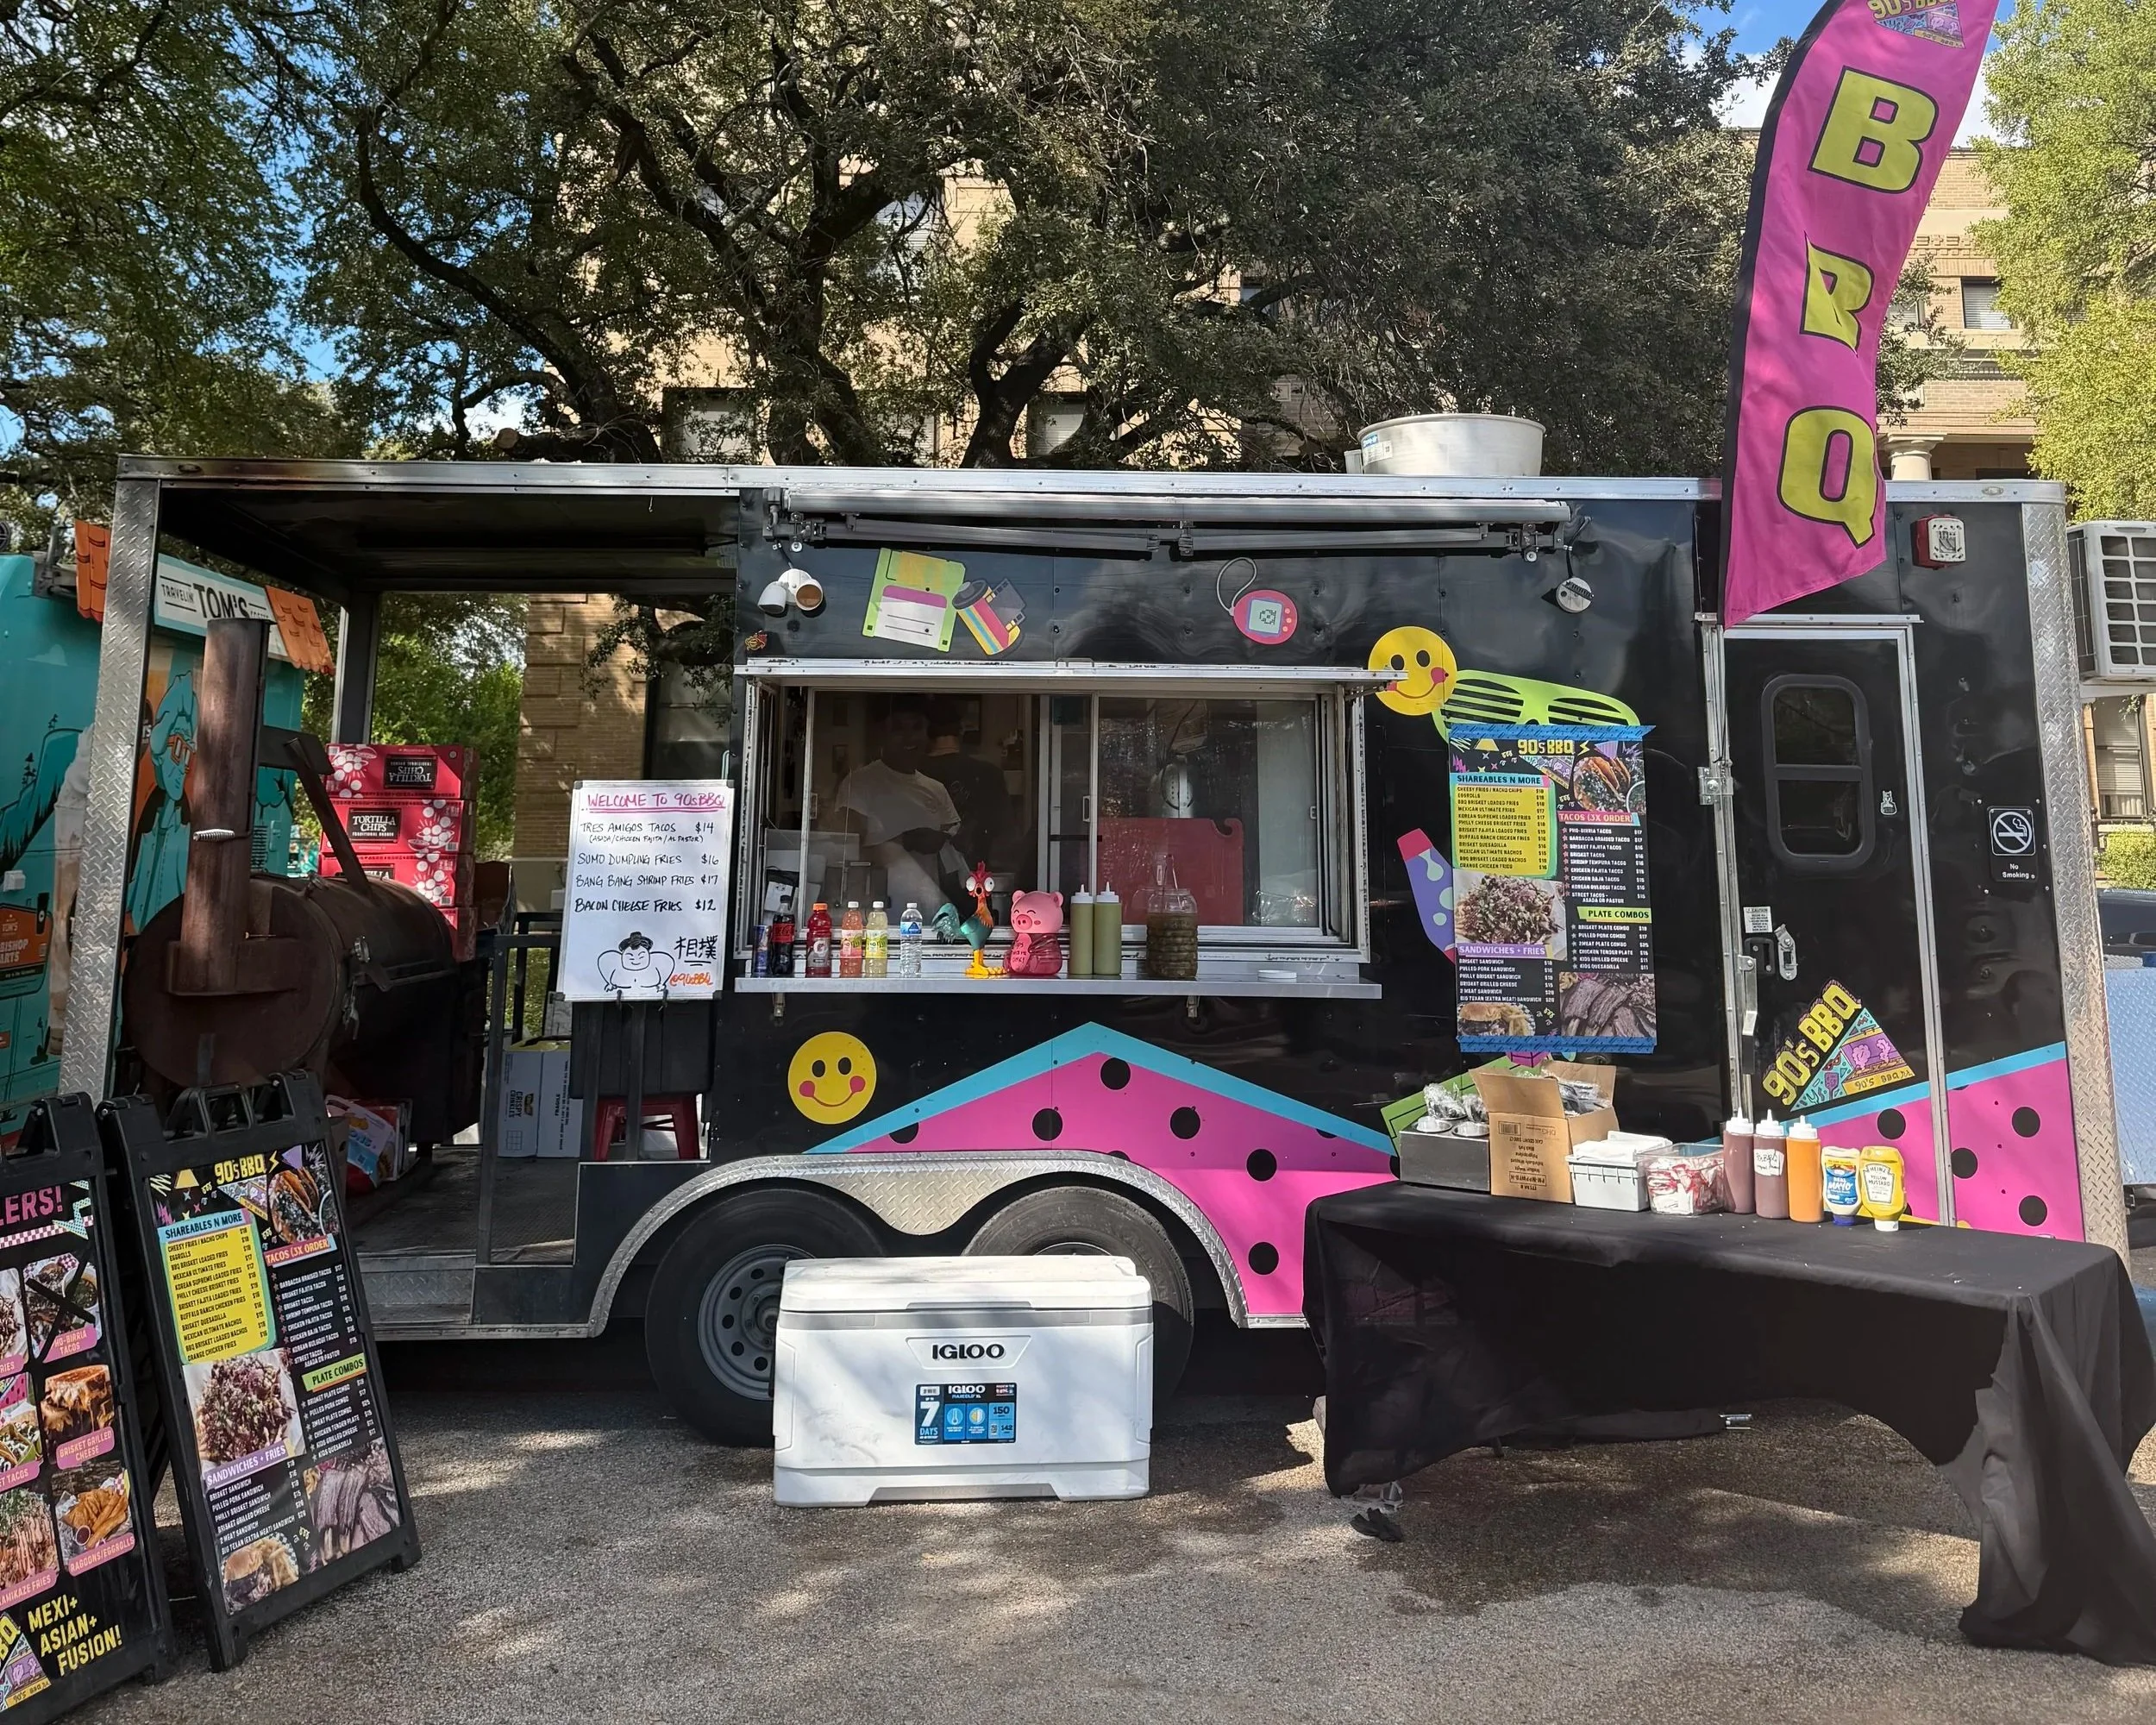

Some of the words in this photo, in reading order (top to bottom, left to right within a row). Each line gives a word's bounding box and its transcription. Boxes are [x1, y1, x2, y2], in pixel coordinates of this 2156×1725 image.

[193, 583, 249, 618] TOM'S
[1546, 739, 1576, 755] BBQ
[389, 772, 432, 782] TORTILLA
[398, 766, 424, 775] CHIPS
[1457, 775, 1508, 784] SHAREABLES
[1518, 776, 1541, 785] MORE
[587, 794, 646, 806] WELCOME
[352, 815, 396, 825] TORTILLA
[1558, 812, 1585, 821] TACOS
[1587, 812, 1601, 822] (3X
[360, 823, 387, 832] CHIPS
[580, 823, 604, 833] TRES
[607, 823, 643, 832] AMIGOS
[649, 823, 676, 832] TACOS
[695, 822, 714, 834] $14
[577, 852, 605, 864] SUMO
[608, 853, 650, 865] DUMPLING
[655, 855, 682, 865] FRIES
[701, 853, 719, 865] $16
[576, 875, 603, 888] BANG
[607, 875, 633, 887] BANG
[636, 875, 667, 886] SHRIMP
[670, 875, 695, 886] FRIES
[700, 875, 718, 886] $17
[2002, 871, 2030, 880] Smoking
[574, 898, 608, 913] BACON
[611, 899, 650, 912] CHEESE
[654, 899, 682, 913] FRIES
[694, 899, 717, 911] $12
[1614, 910, 1650, 919] COMBOS
[1458, 945, 1515, 955] SANDWICHES
[1797, 982, 1863, 1053] BBQ
[1854, 1077, 1875, 1091] 90'S
[1880, 1073, 1900, 1082] BBQ
[239, 1154, 266, 1177] BBQ
[165, 1220, 212, 1238] SHAREABLES
[212, 1218, 219, 1227] N
[222, 1213, 241, 1225] MORE
[266, 1250, 290, 1264] TACOS
[290, 1245, 303, 1257] (3X
[173, 1270, 191, 1280] MEXICAN
[192, 1265, 213, 1275] ULTIMATE
[177, 1290, 191, 1299] PHILLY
[191, 1286, 208, 1295] CHEESE
[209, 1281, 226, 1290] BRISKET
[60, 1344, 81, 1355] TACOS
[932, 1343, 1006, 1360] IGLOO
[312, 1371, 332, 1384] PLATE
[334, 1358, 363, 1376] COMBOS
[948, 1384, 987, 1395] IGLOO
[919, 1401, 940, 1427] 7
[993, 1406, 1011, 1414] 150
[919, 1427, 938, 1436] DAYS
[60, 1440, 86, 1458] BRISKET
[87, 1430, 112, 1446] GRILLED
[75, 1446, 99, 1462] CHEESE
[207, 1456, 258, 1485] SANDWICHES
[265, 1445, 285, 1460] FRIES
[7, 1468, 28, 1484] TACOS
[70, 1535, 135, 1573] RAGOONS/EGGROLLS
[32, 1574, 51, 1591] FRIES
[28, 1594, 78, 1633] MEXI+
[40, 1613, 97, 1658] ASIAN+
[57, 1624, 122, 1677] FUSION!
